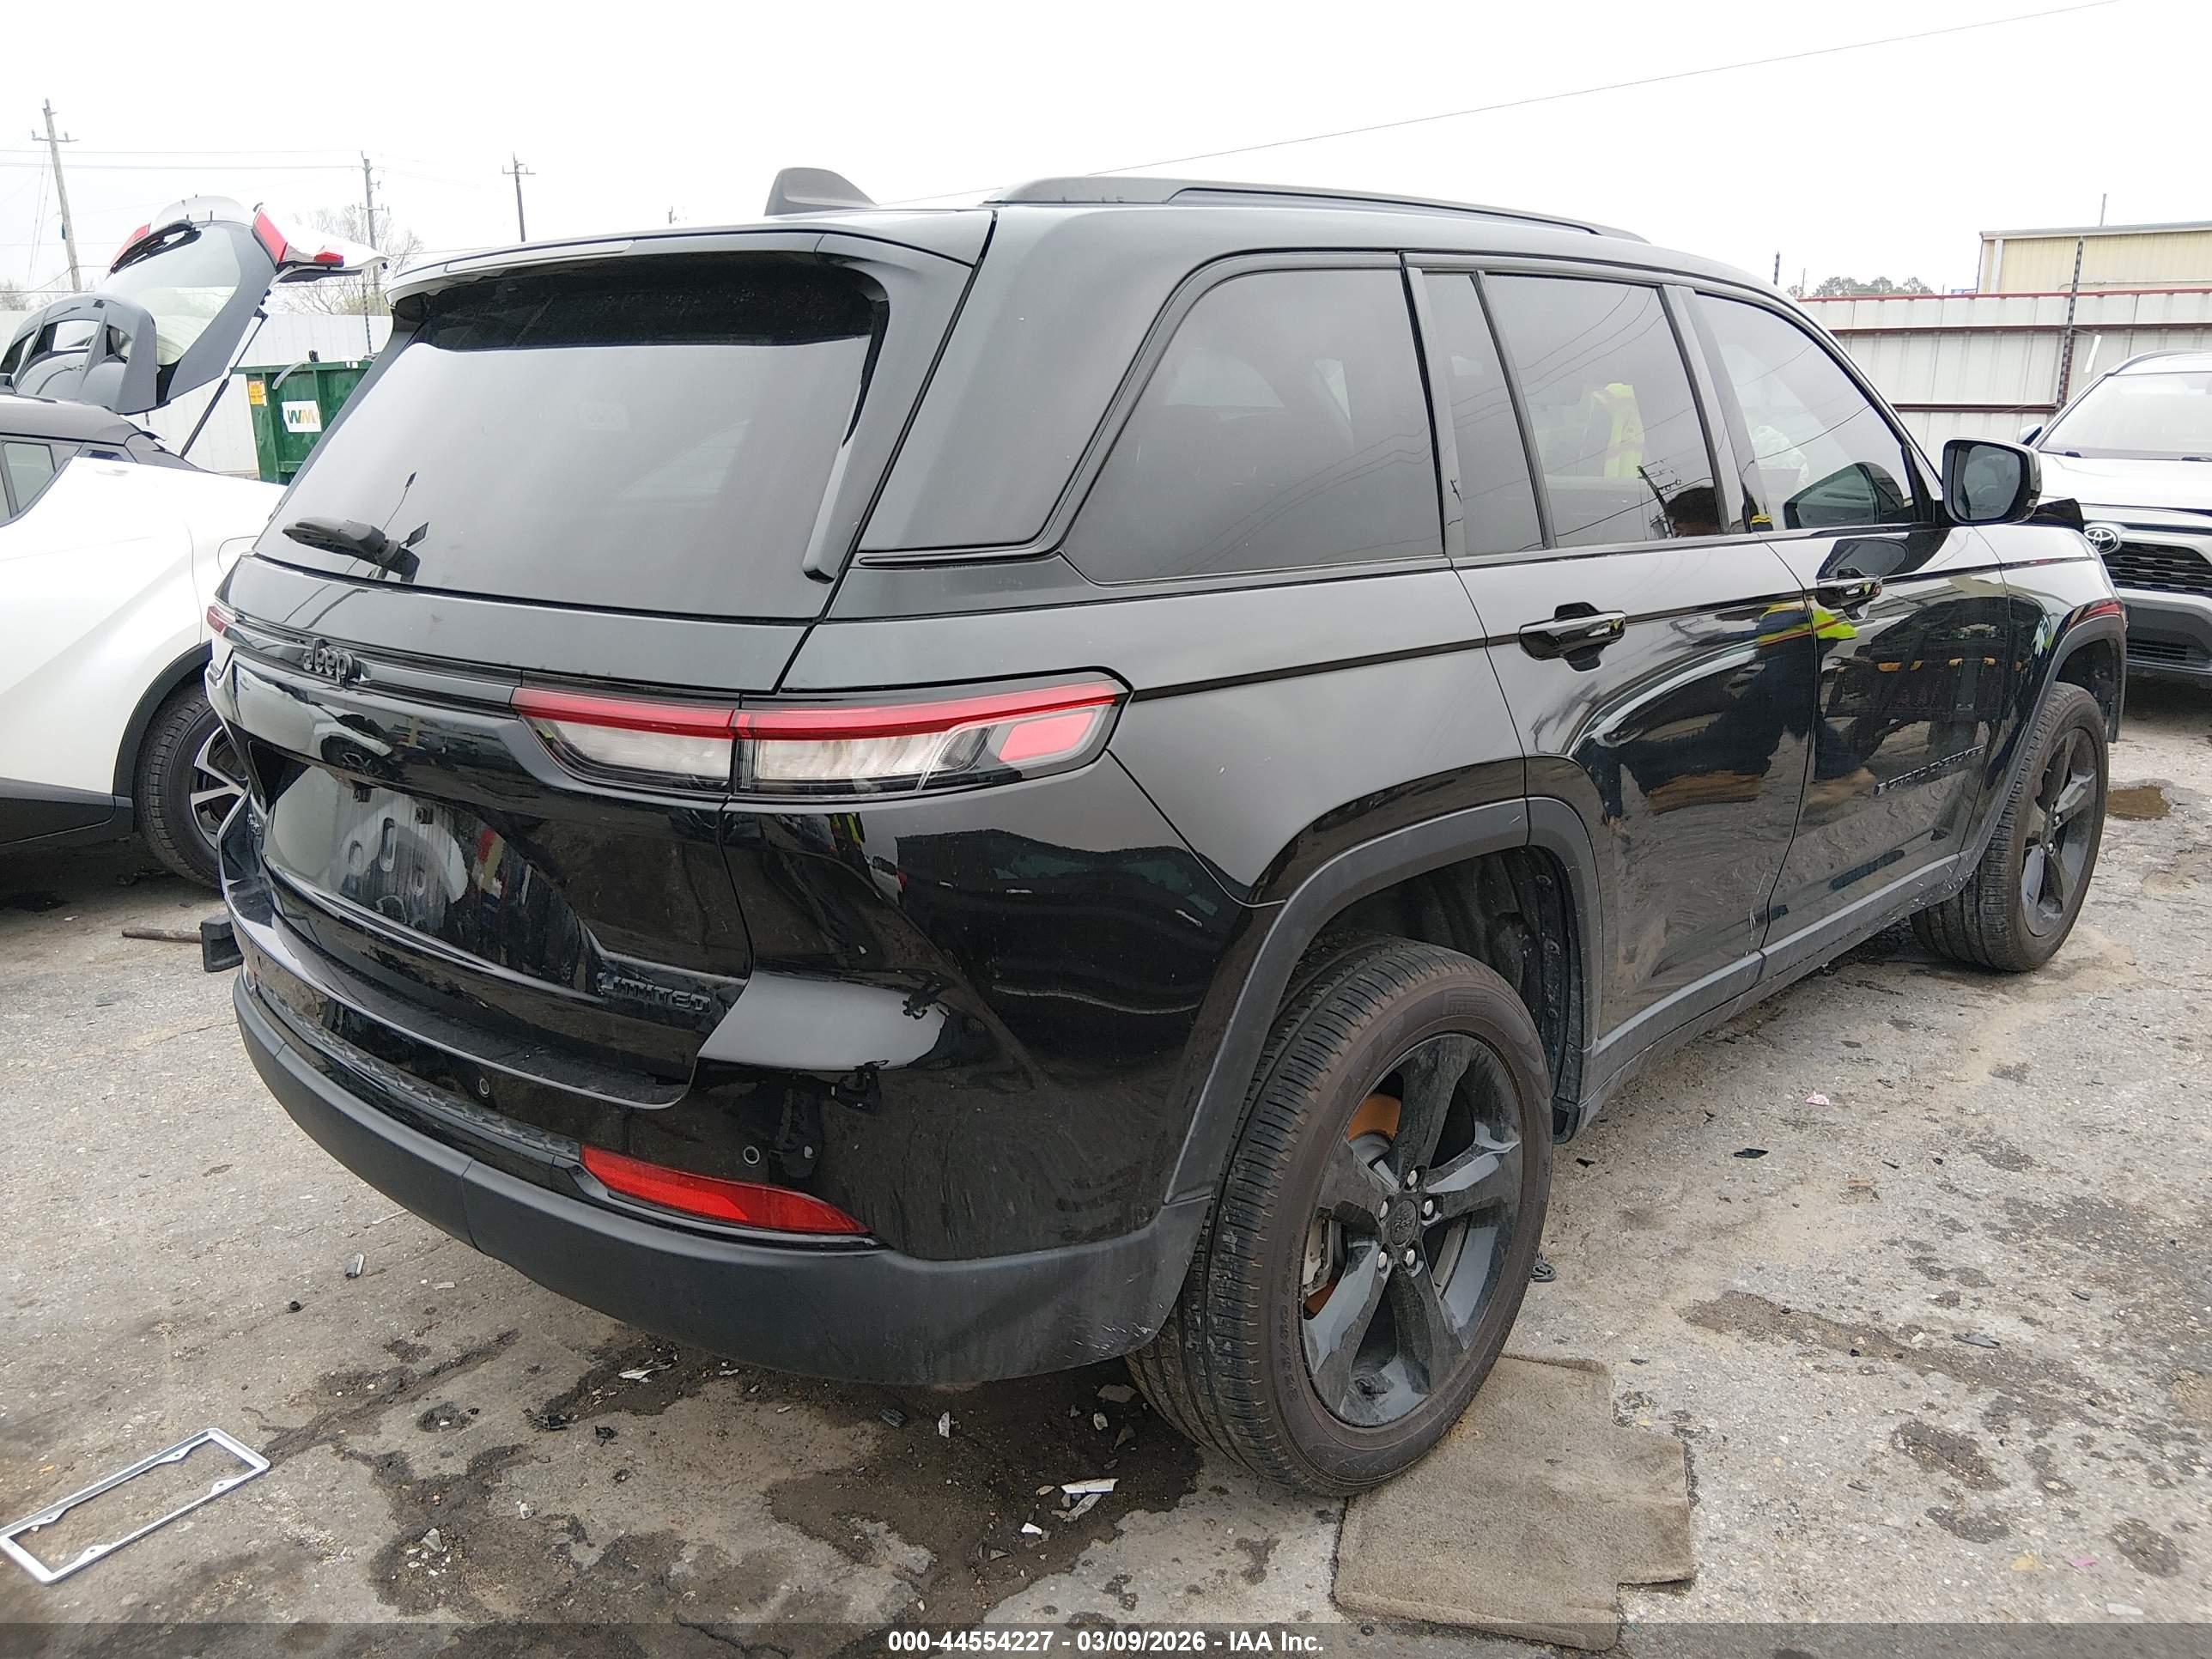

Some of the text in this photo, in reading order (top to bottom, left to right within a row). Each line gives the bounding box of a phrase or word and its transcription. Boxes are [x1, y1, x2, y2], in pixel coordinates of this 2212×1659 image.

[287, 409, 317, 424] WM
[303, 637, 354, 685] Jeep
[597, 971, 712, 1013] LIMITED
